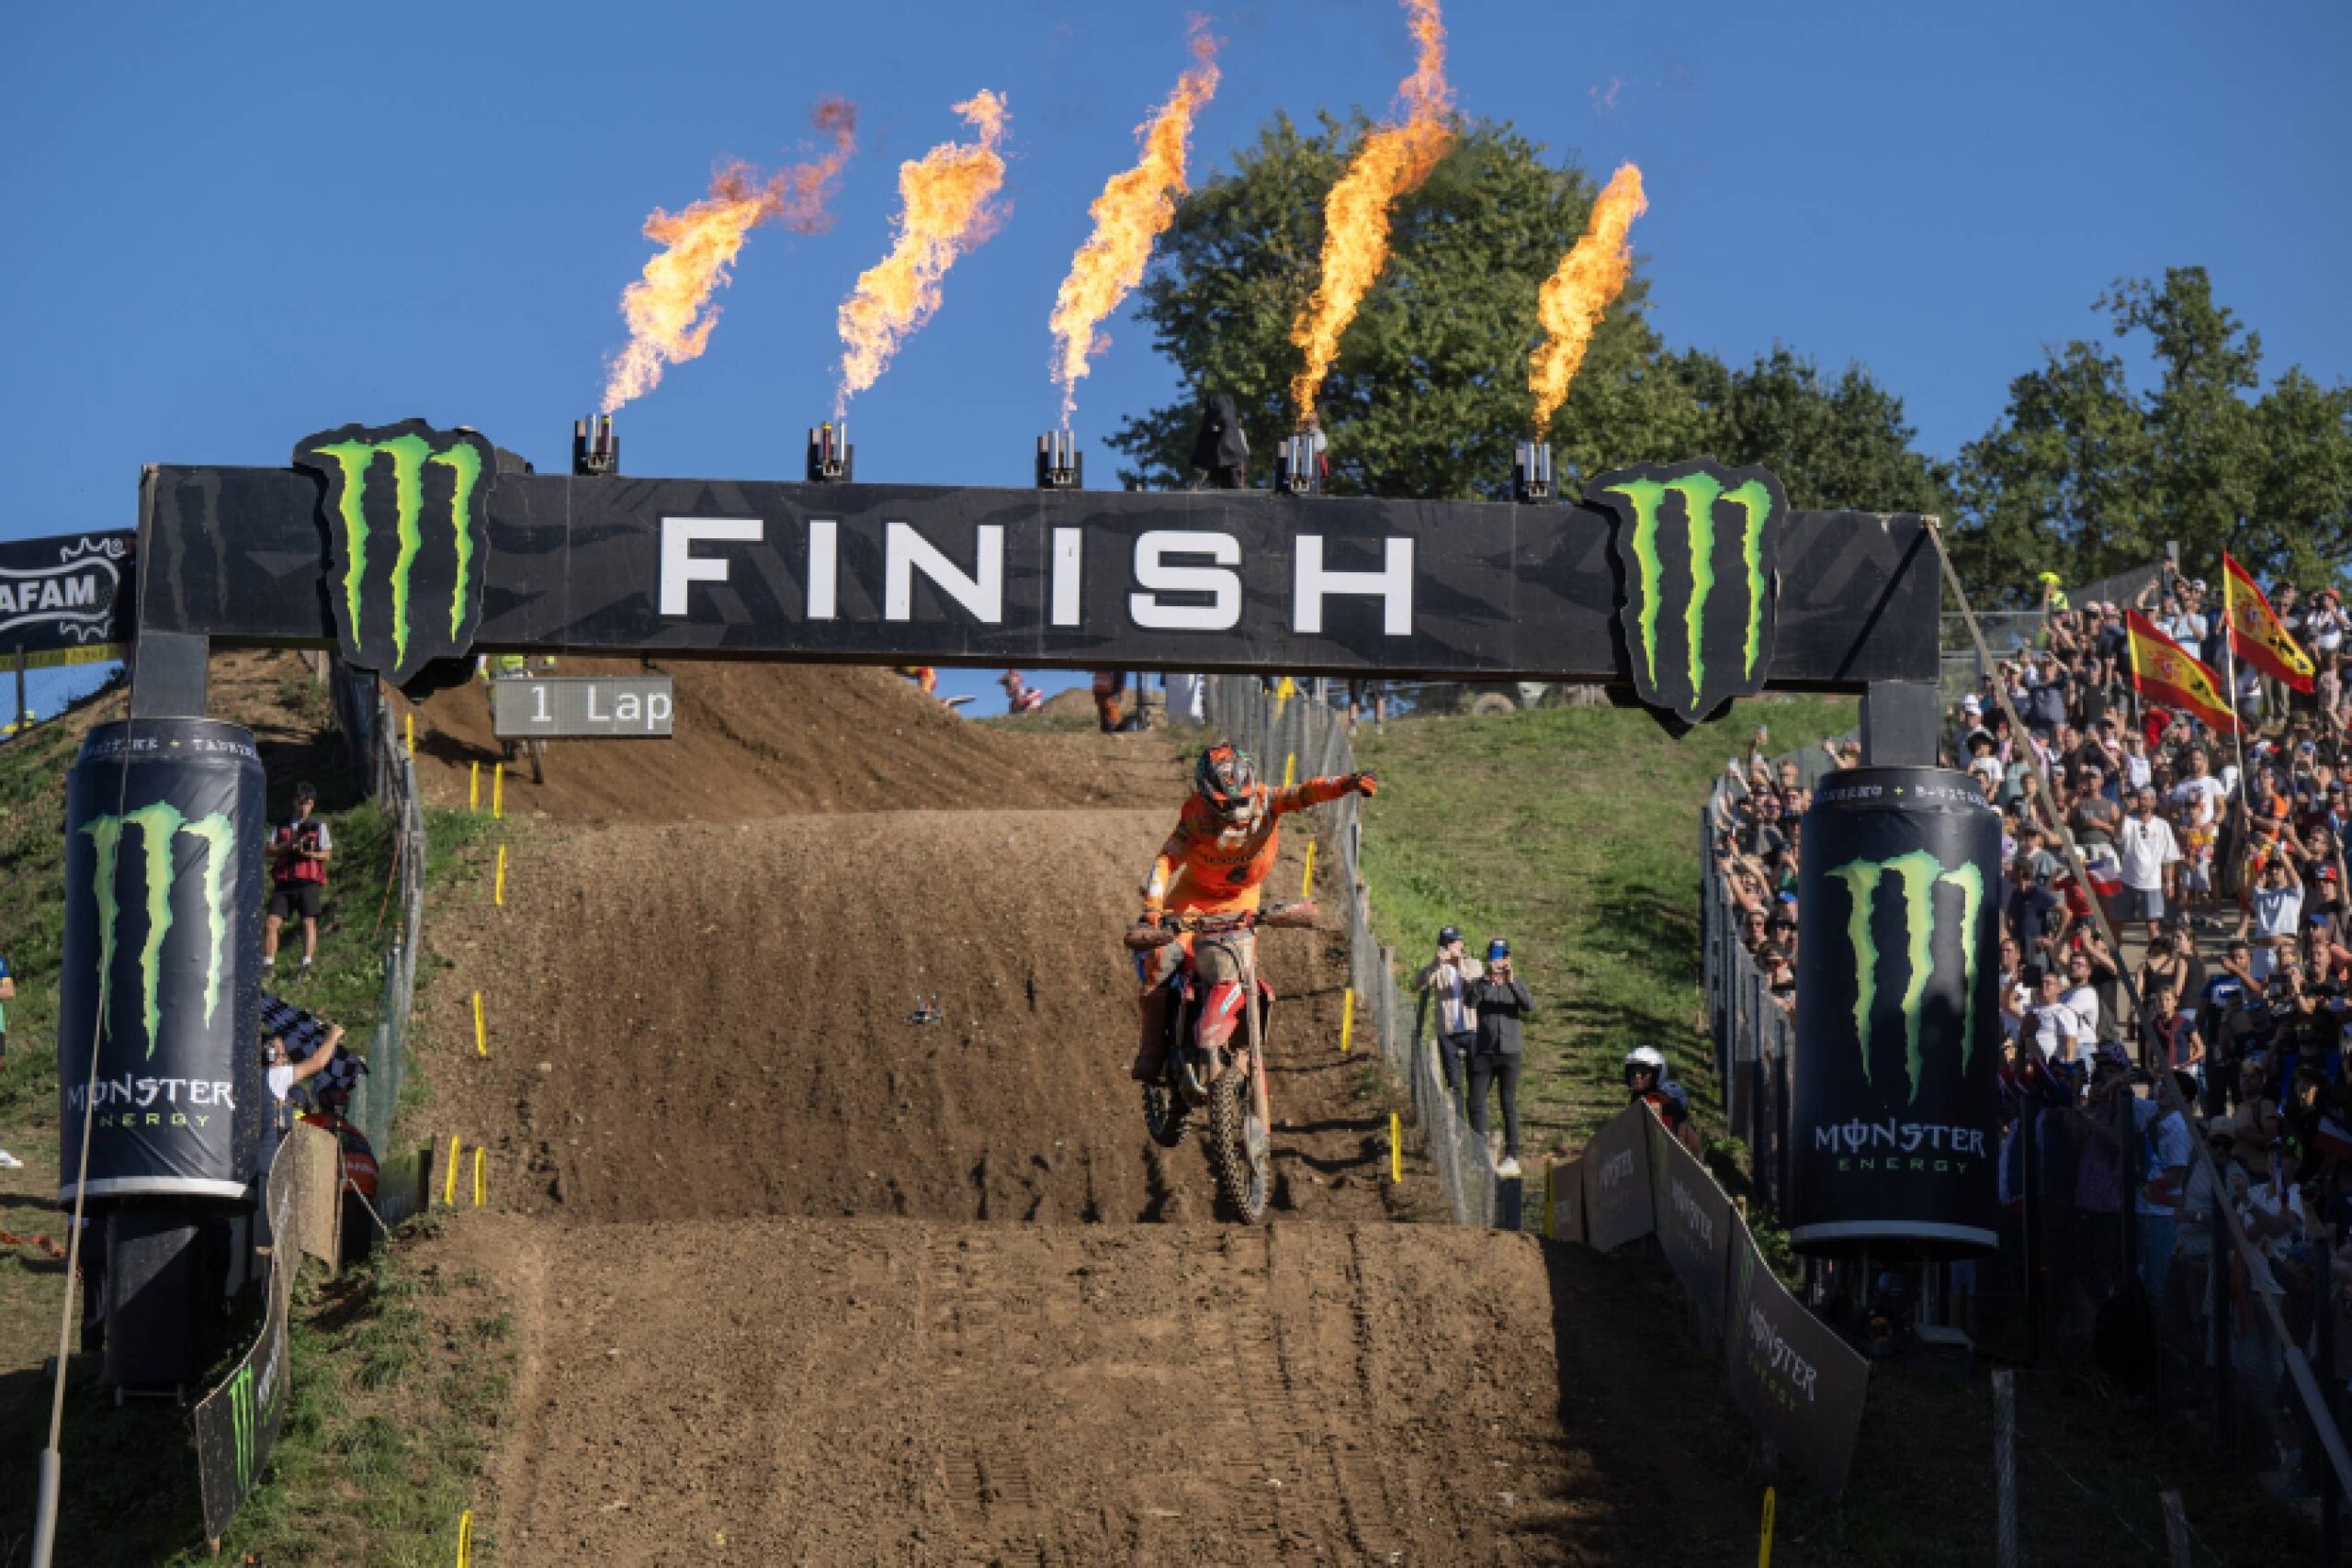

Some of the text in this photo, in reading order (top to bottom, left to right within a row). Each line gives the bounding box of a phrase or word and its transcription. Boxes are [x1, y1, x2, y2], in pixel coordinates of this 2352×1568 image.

[659, 517, 1414, 636] FINISH
[530, 683, 673, 730] 1 Lap
[90, 1112, 209, 1128] NERGY
[1815, 1117, 1986, 1158] MONSTER
[1838, 1156, 1968, 1174] ENERGY
